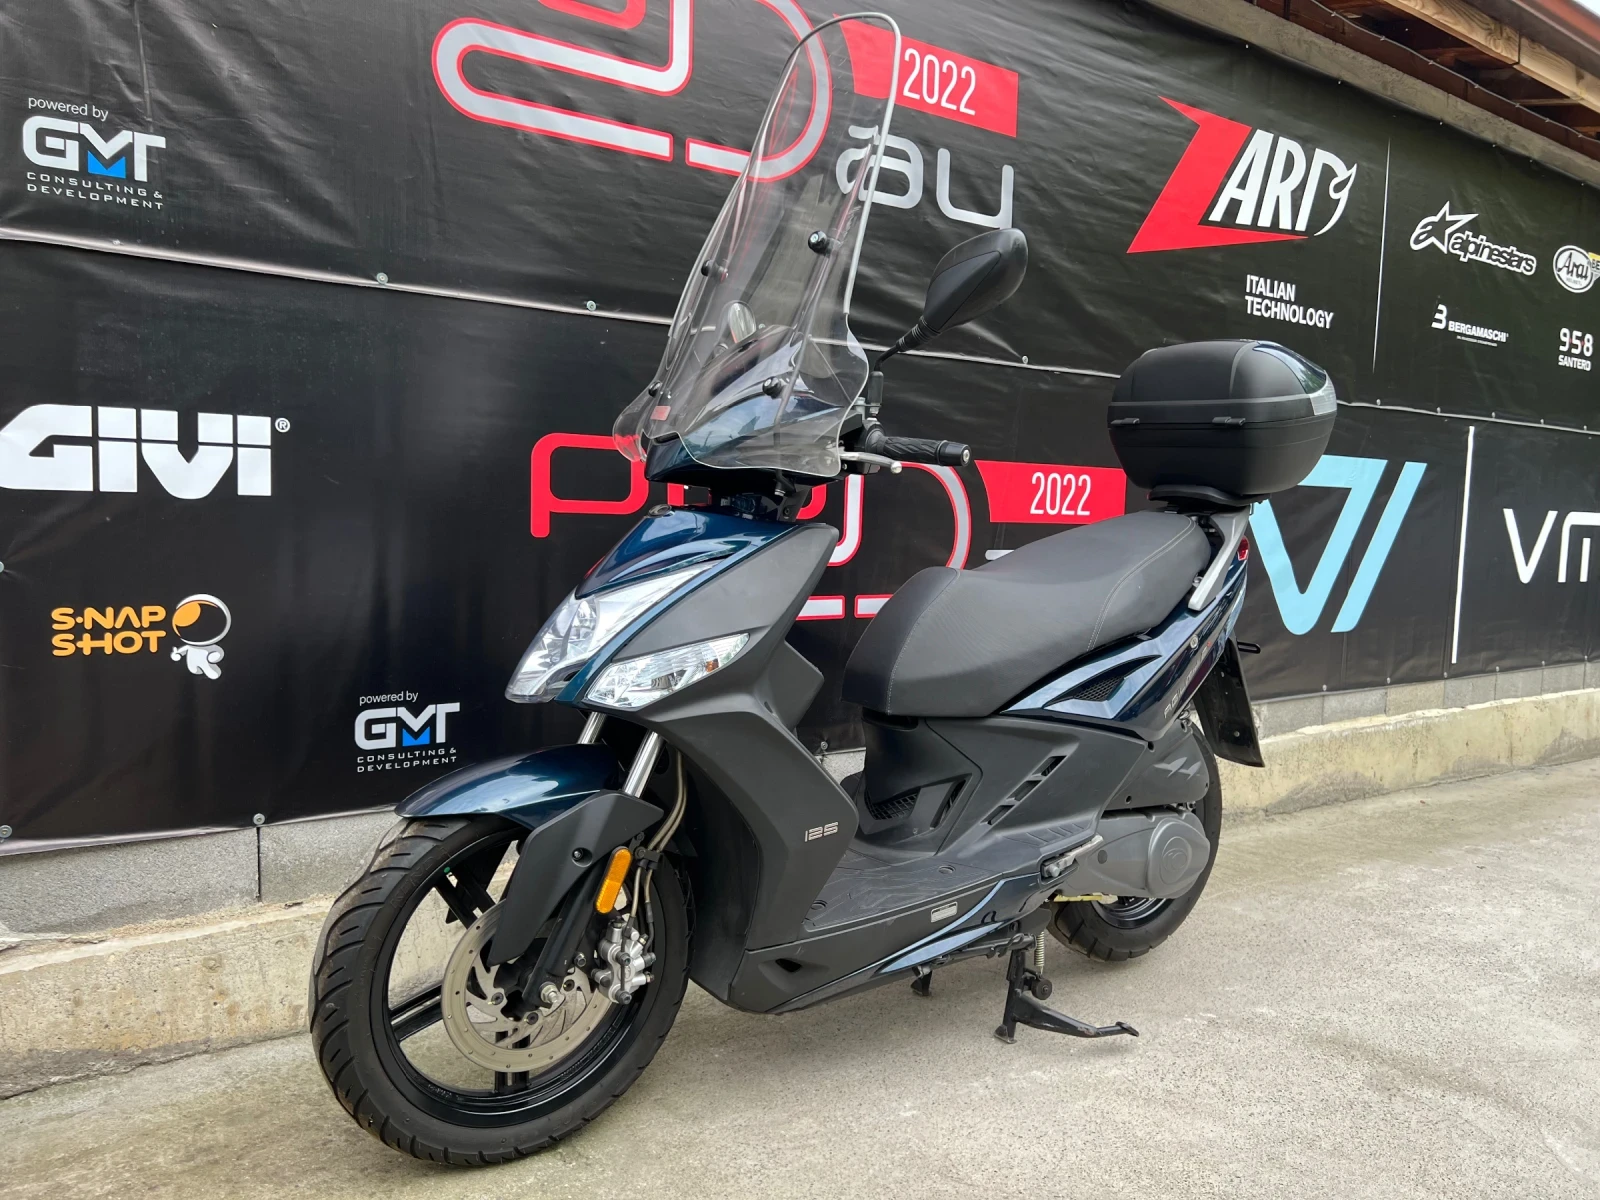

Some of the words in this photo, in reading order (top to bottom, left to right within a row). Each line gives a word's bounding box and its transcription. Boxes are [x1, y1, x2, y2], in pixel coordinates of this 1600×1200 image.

[903, 47, 977, 116] 2022
[28, 97, 88, 116] powered
[92, 105, 109, 121] by
[23, 116, 166, 182] GMT
[27, 171, 148, 197] CONSULTING
[153, 190, 164, 199] &
[27, 183, 164, 210] DEVELOPMENT
[1450, 230, 1537, 276] alpinestars
[1245, 274, 1296, 302] ITALIAN
[1244, 295, 1334, 329] TECHNOLOGY
[1448, 320, 1507, 343] BERGAMASCHI
[1558, 355, 1592, 371] SANTERO
[0, 403, 272, 500] GIVI
[1030, 471, 1092, 516] 2022
[359, 691, 404, 706] powered
[406, 690, 419, 702] by
[354, 702, 461, 750] GMT
[357, 748, 446, 763] CONSULTING
[357, 756, 457, 773] DEVELOPMENT
[804, 821, 839, 843] 125
